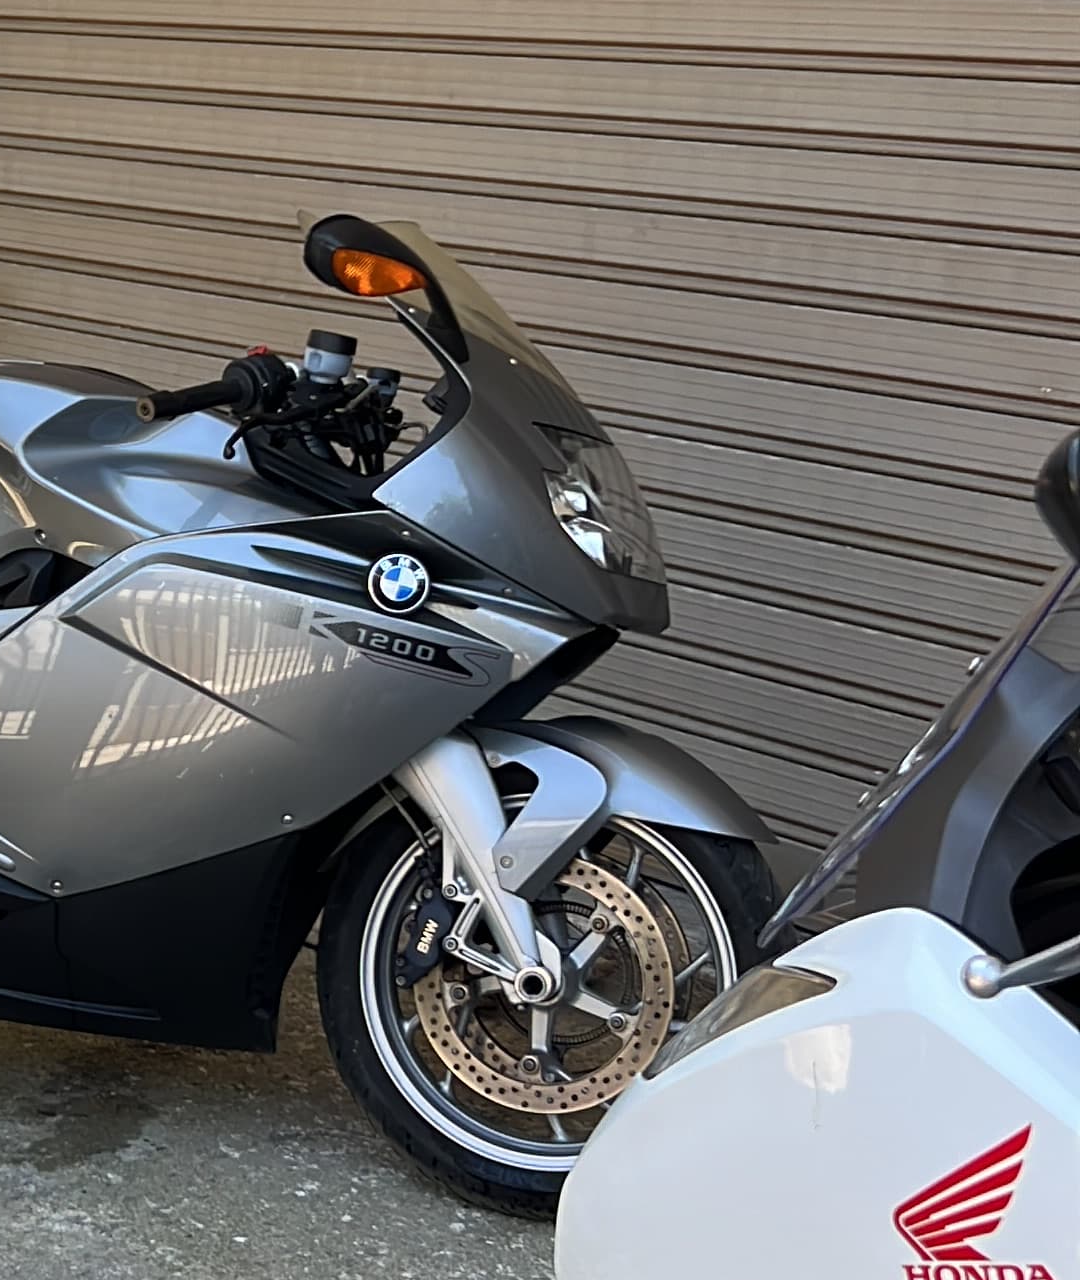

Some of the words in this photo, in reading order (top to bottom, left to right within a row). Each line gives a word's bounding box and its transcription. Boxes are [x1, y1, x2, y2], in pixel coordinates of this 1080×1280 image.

[379, 556, 425, 580] BMW
[356, 627, 436, 663] 1200
[416, 919, 439, 954] BMW
